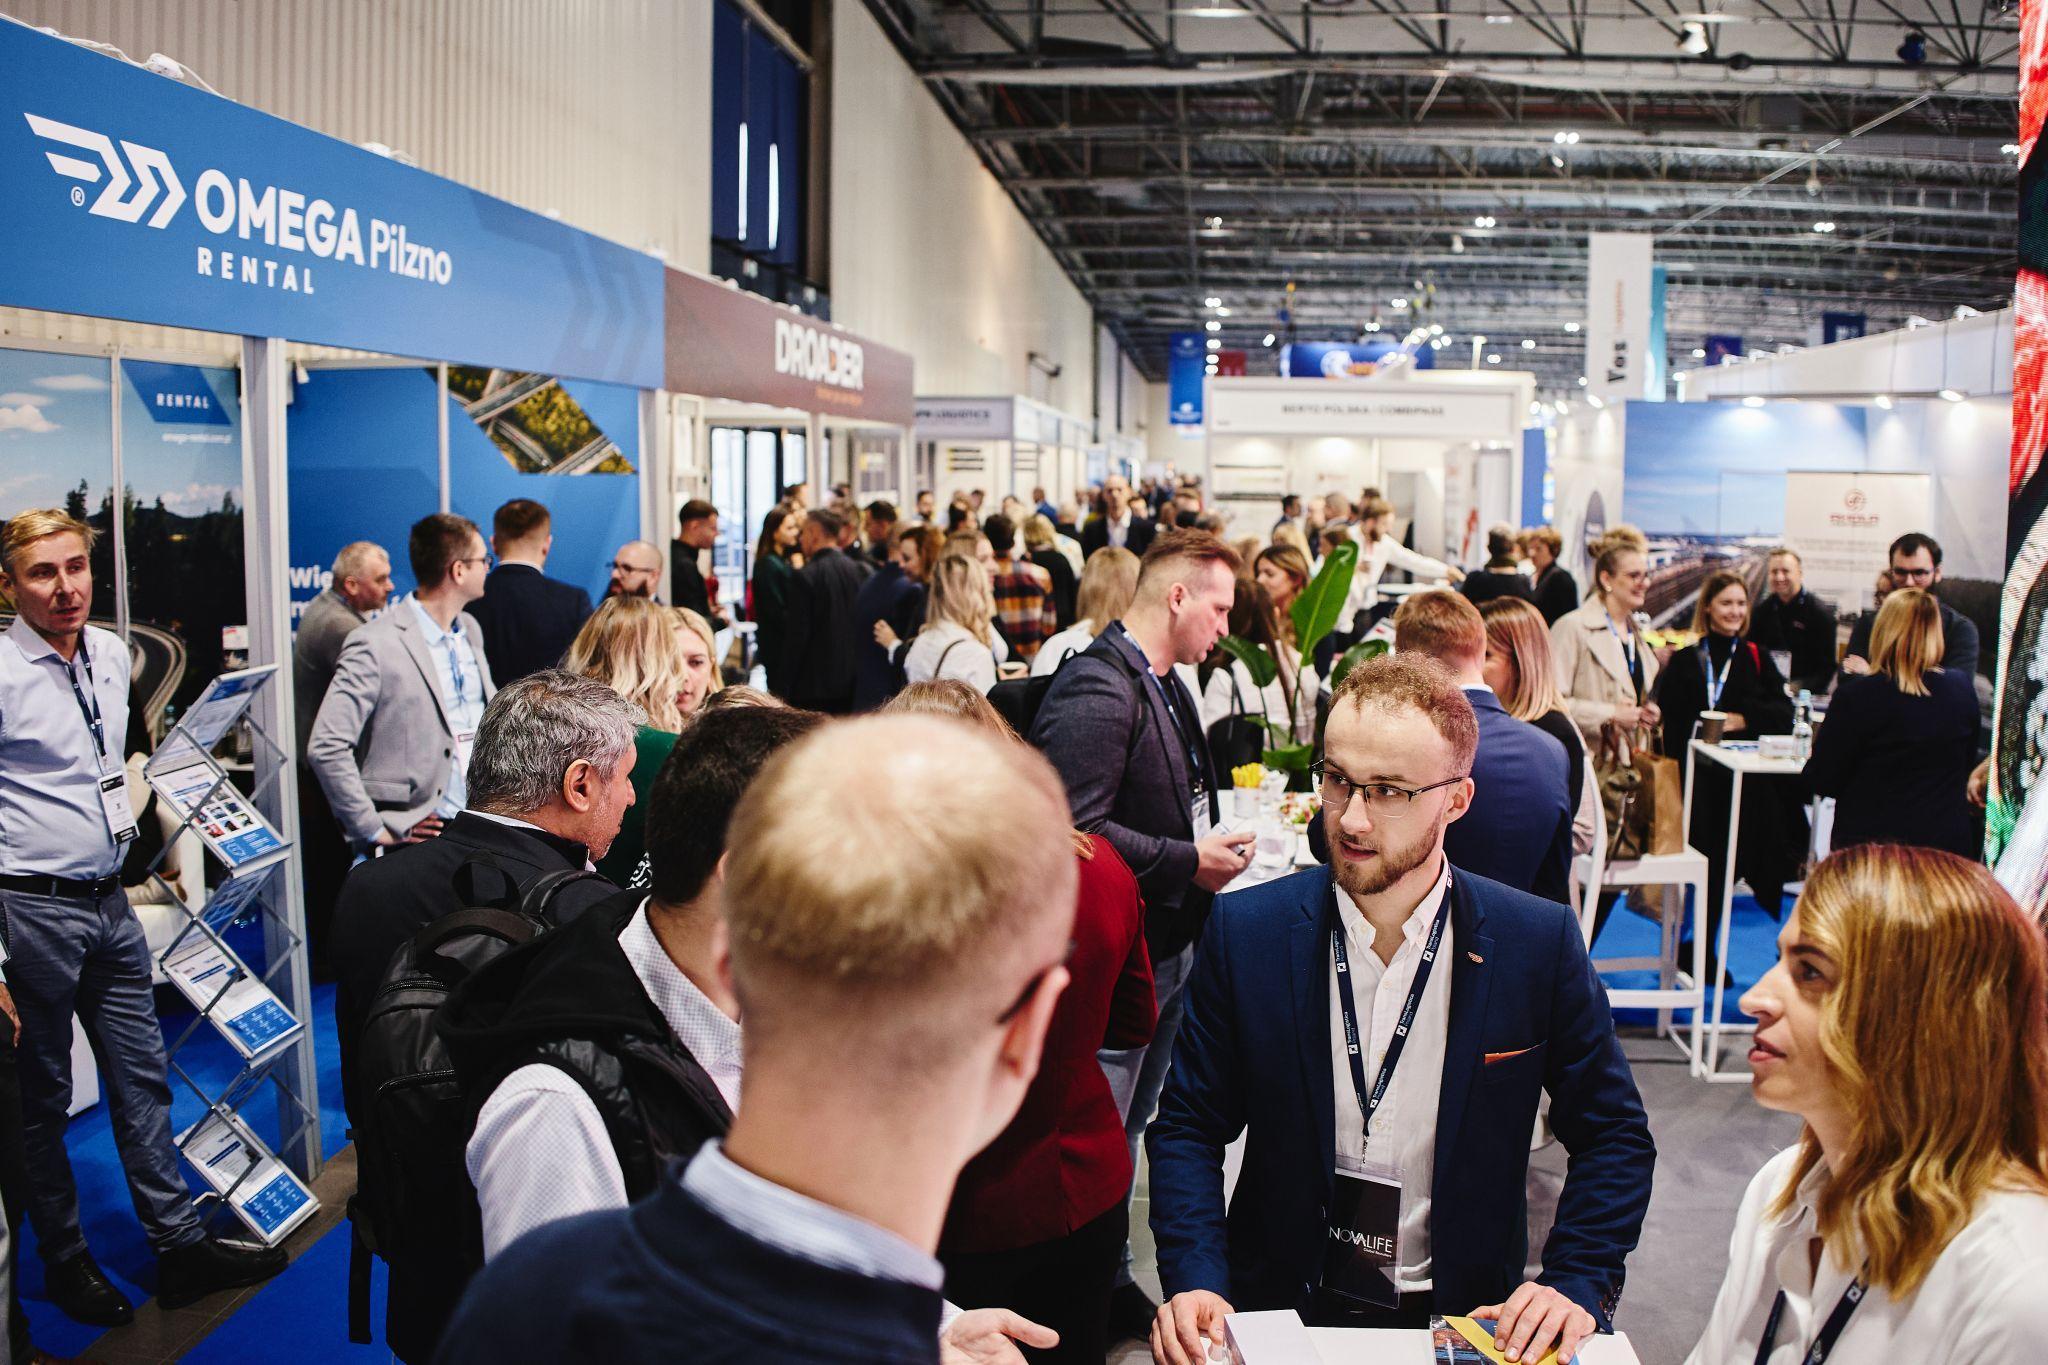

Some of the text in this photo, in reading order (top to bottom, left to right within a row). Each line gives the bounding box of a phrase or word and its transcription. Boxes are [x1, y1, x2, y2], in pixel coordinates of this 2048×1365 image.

[194, 169, 452, 286] OMEGA Pilzno
[197, 246, 314, 295] RENTAL
[156, 392, 209, 410] RENTAL
[1328, 1226, 1393, 1254] NOVALIFE
